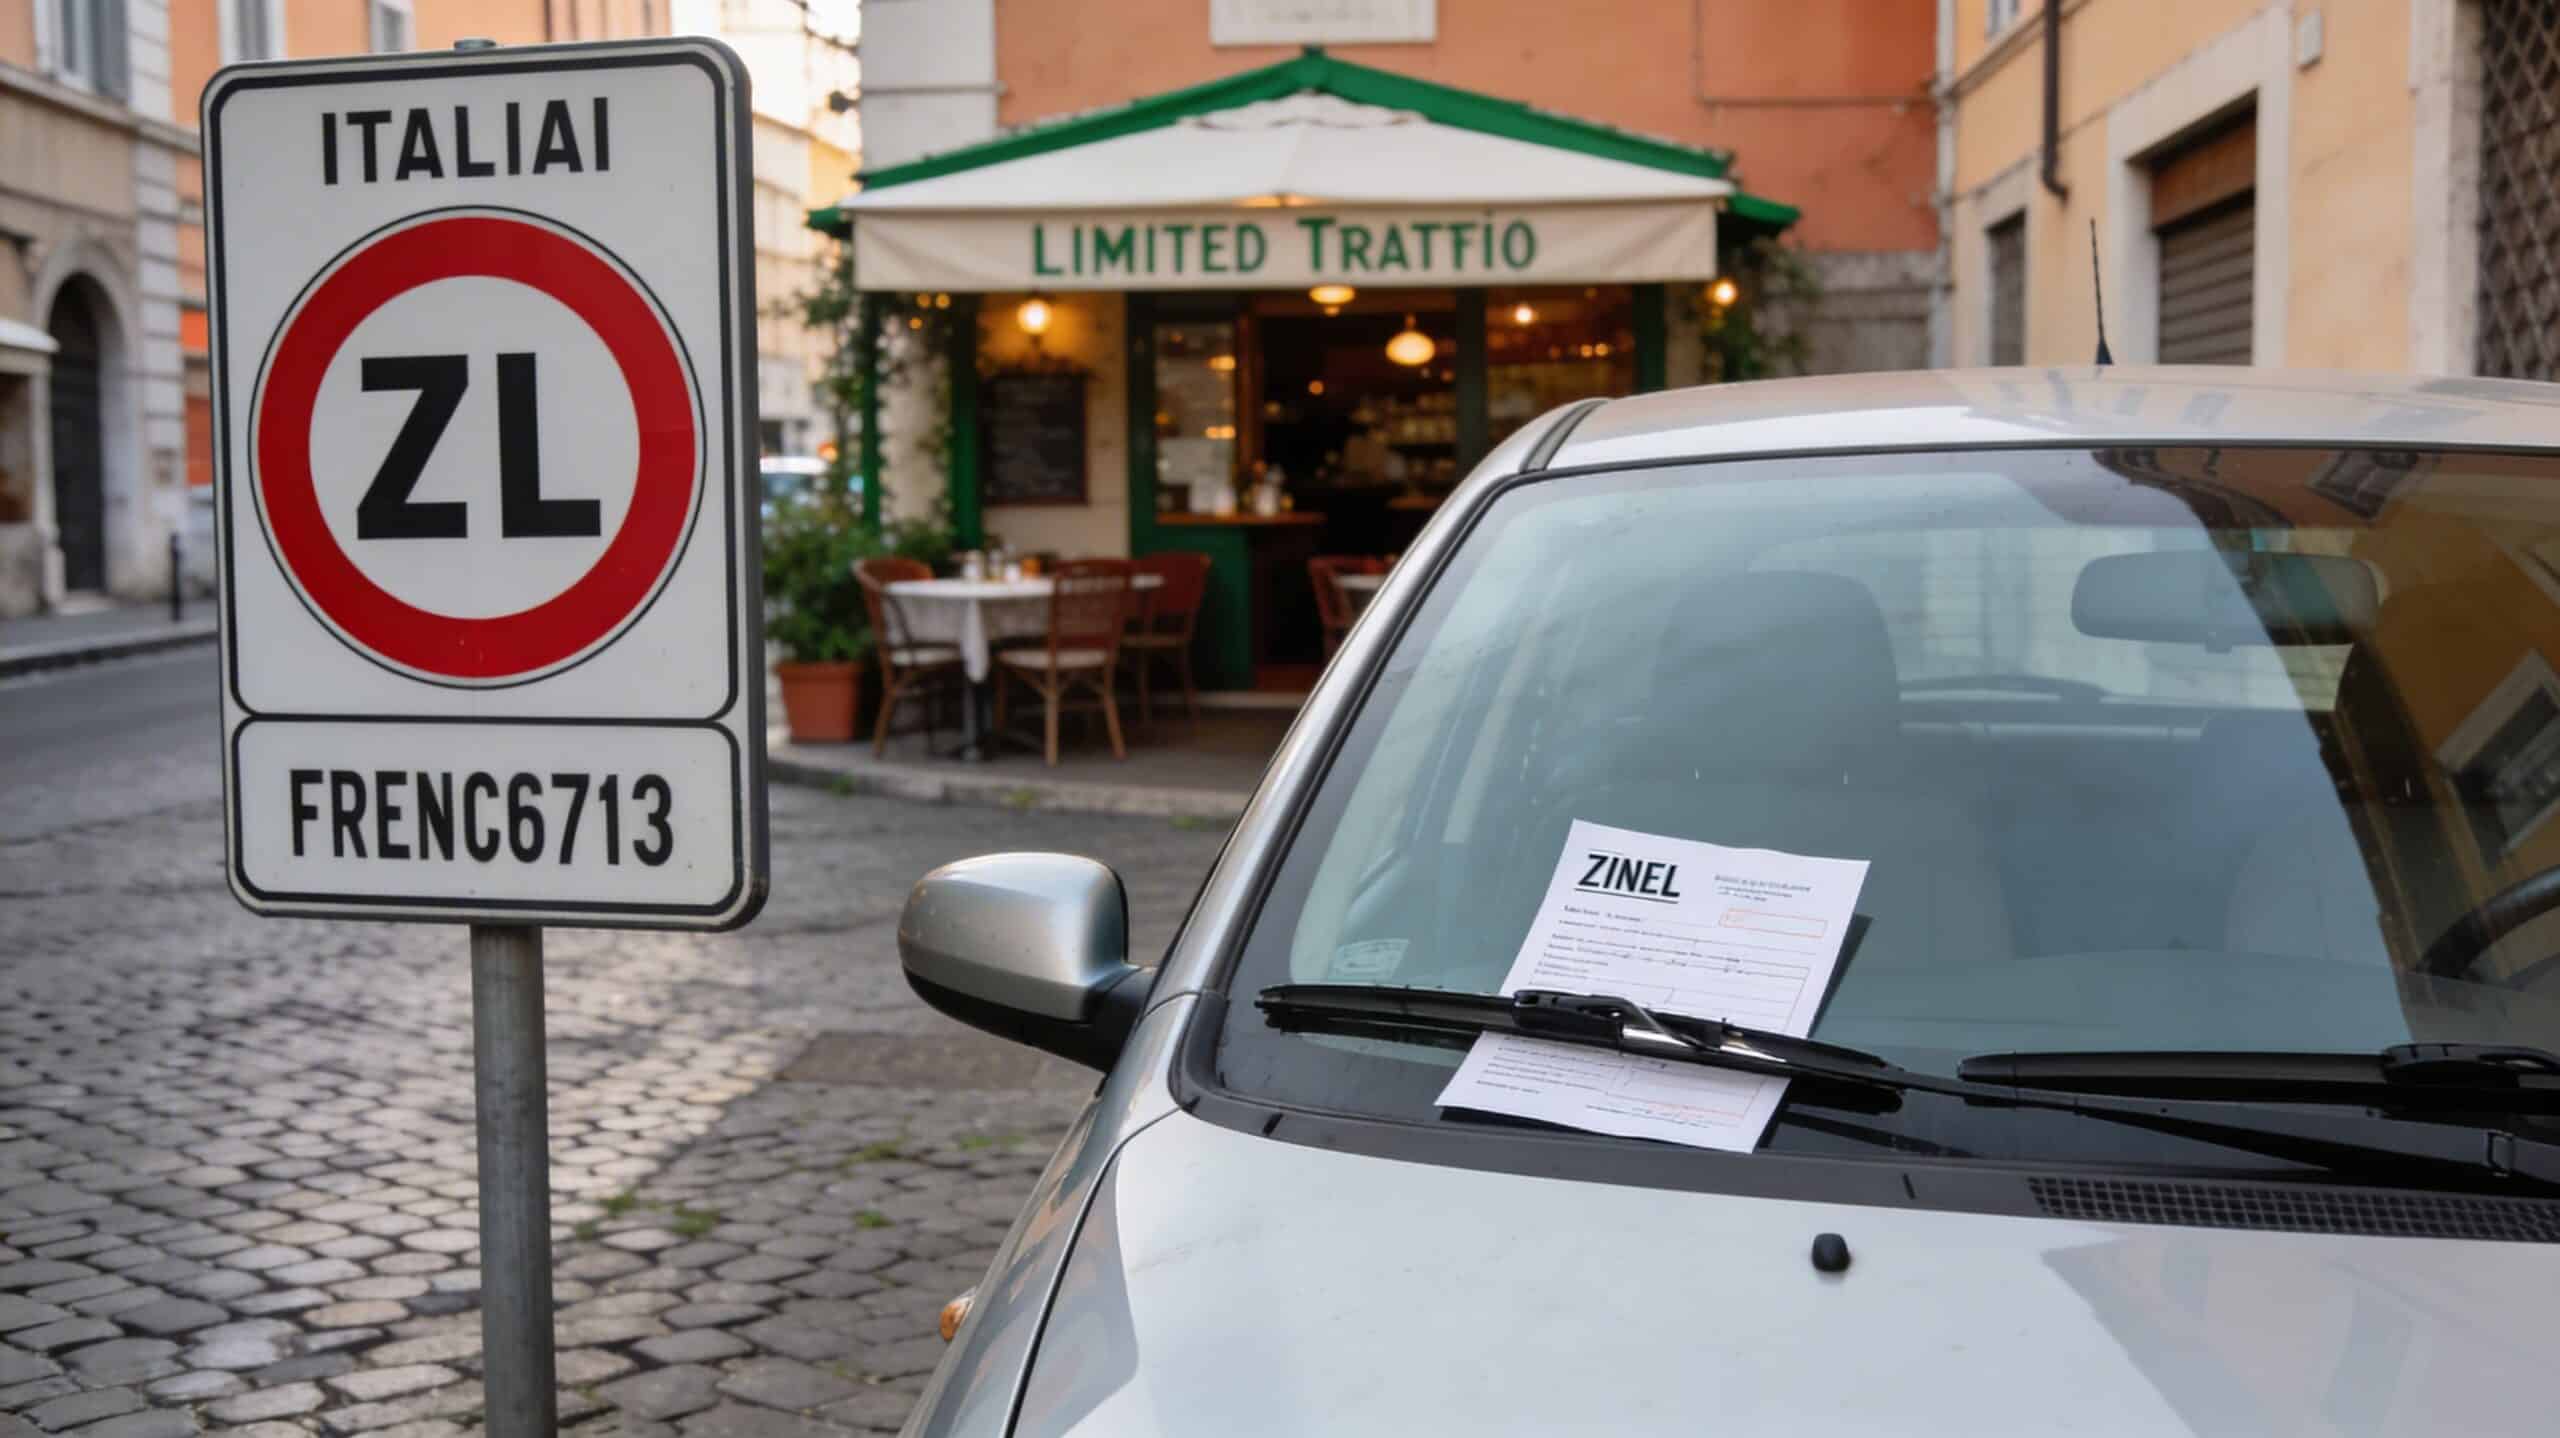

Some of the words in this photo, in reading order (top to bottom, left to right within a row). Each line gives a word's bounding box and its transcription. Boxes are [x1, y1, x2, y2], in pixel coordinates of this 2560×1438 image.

[322, 97, 610, 186] ITALIAI
[1033, 221, 1267, 275] LIMITED
[356, 352, 602, 540] ZL
[290, 769, 674, 867] FRENC6713
[1578, 853, 1681, 898] ZINEL
